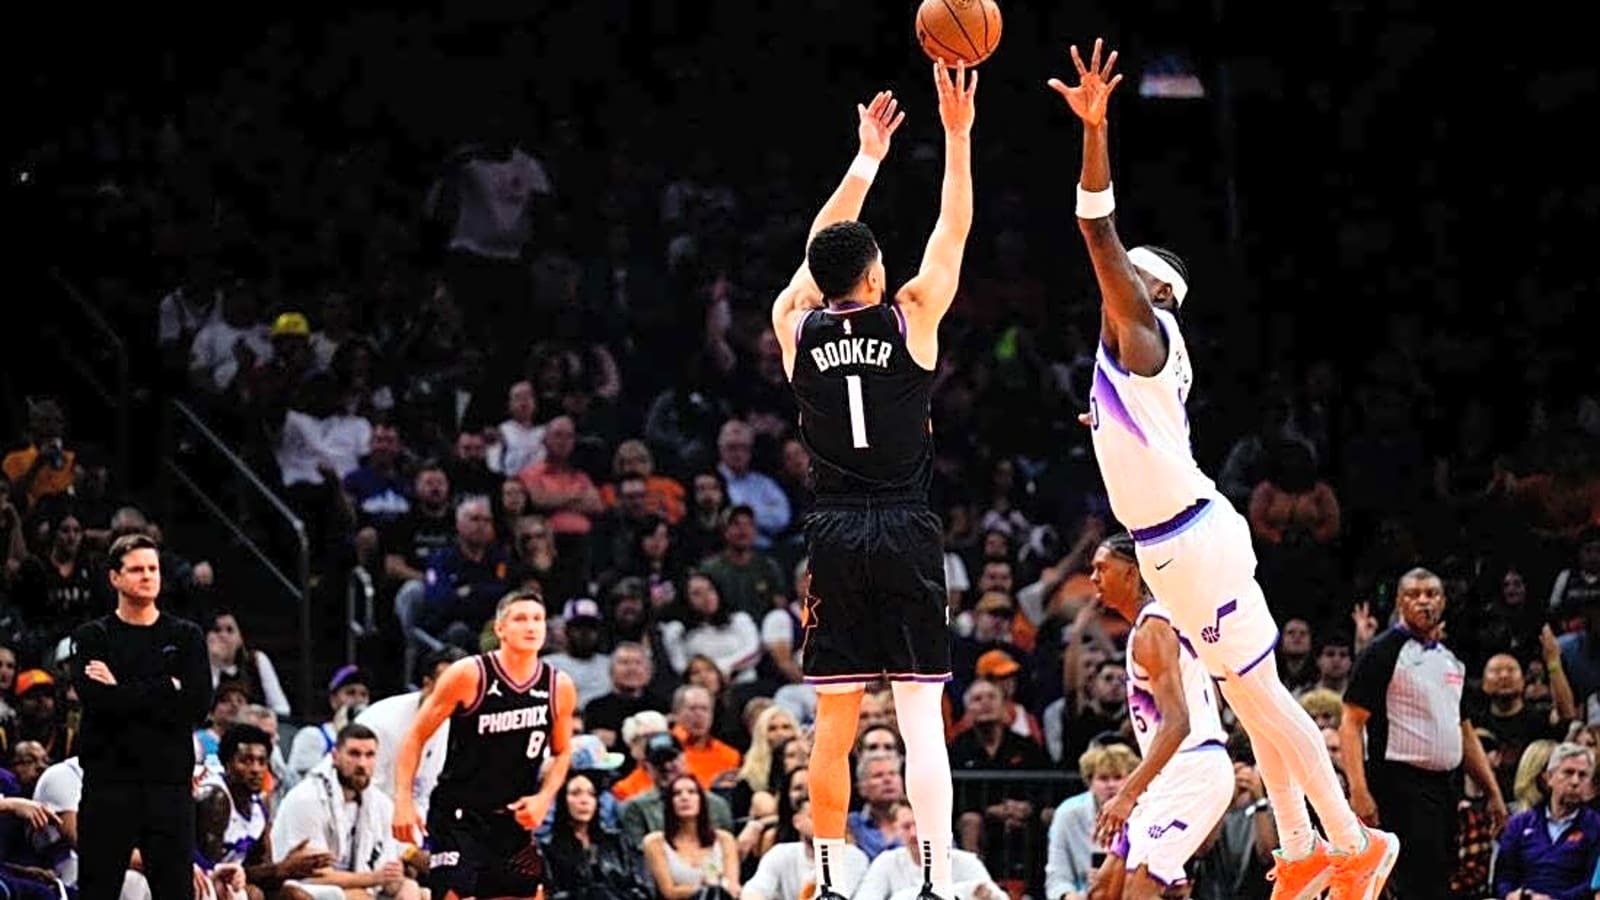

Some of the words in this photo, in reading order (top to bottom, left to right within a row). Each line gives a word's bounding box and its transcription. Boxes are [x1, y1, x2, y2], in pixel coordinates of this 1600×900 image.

[811, 338, 893, 373] BOOKER
[846, 375, 869, 449] 1
[478, 705, 548, 735] PHOENIX
[1131, 705, 1147, 734] 5
[526, 731, 545, 758] 8
